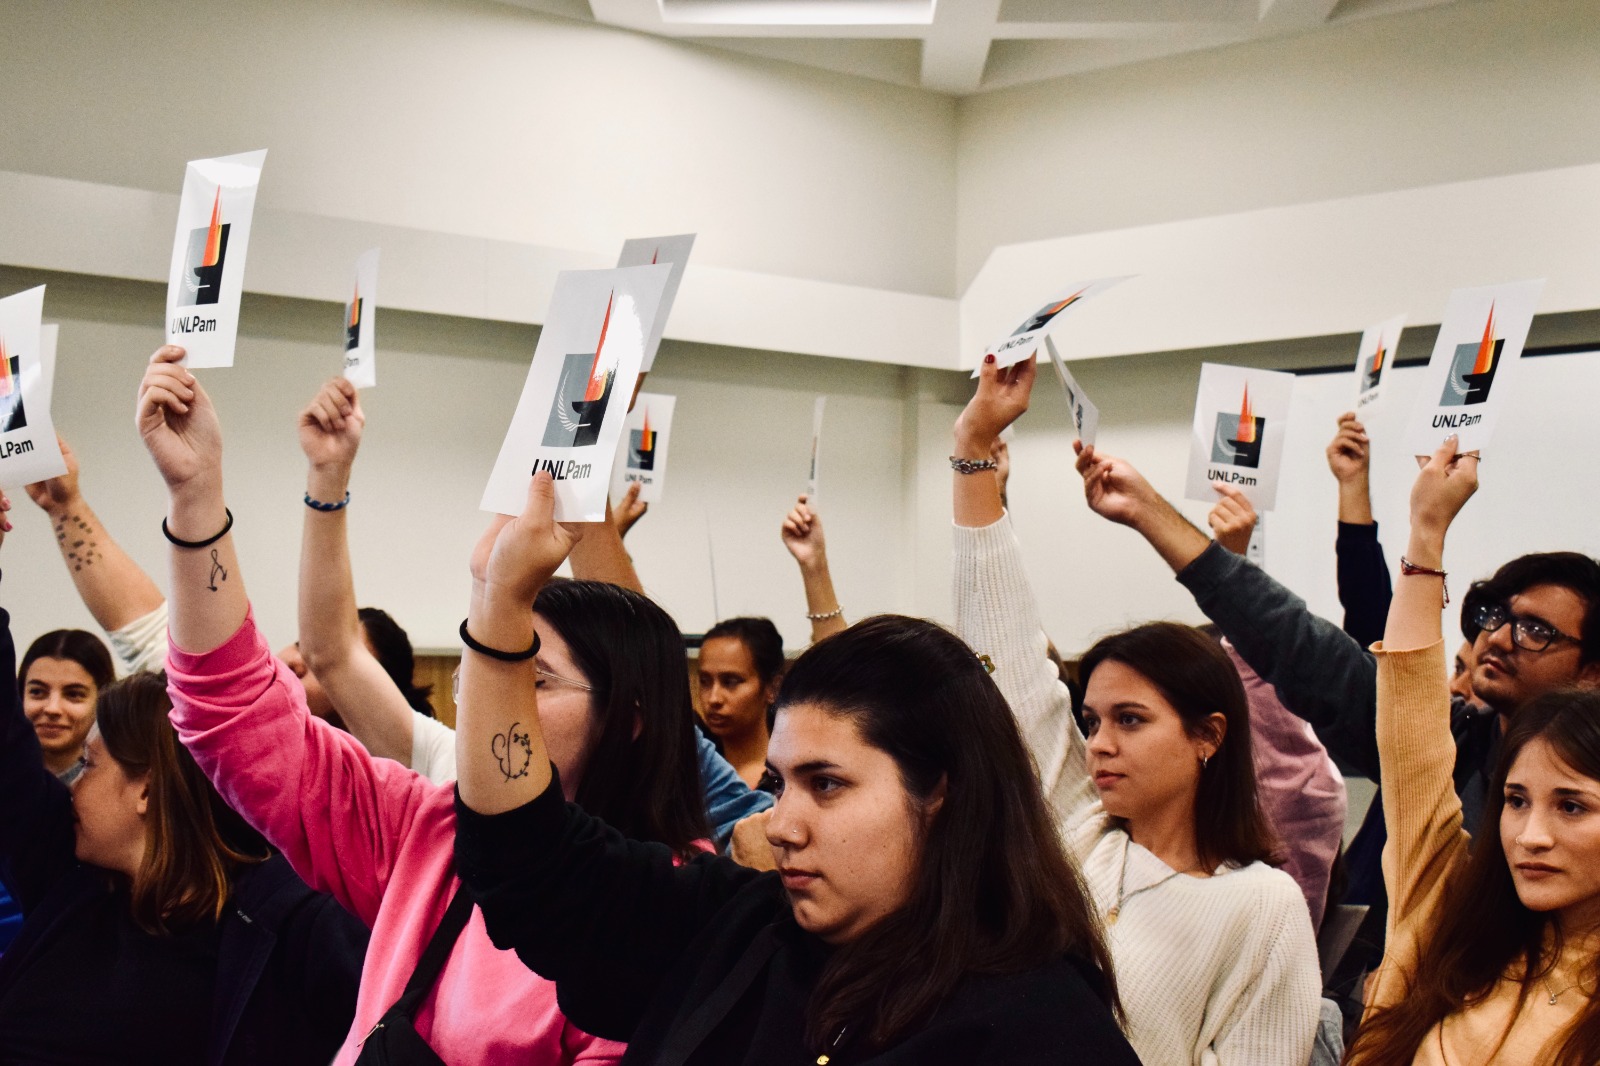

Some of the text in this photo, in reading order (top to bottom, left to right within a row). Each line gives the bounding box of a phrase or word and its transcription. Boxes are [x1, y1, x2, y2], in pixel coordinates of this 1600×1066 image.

[171, 315, 217, 335] UNLPam
[1431, 413, 1482, 428] UNLPam
[1207, 469, 1258, 487] UNLPam
